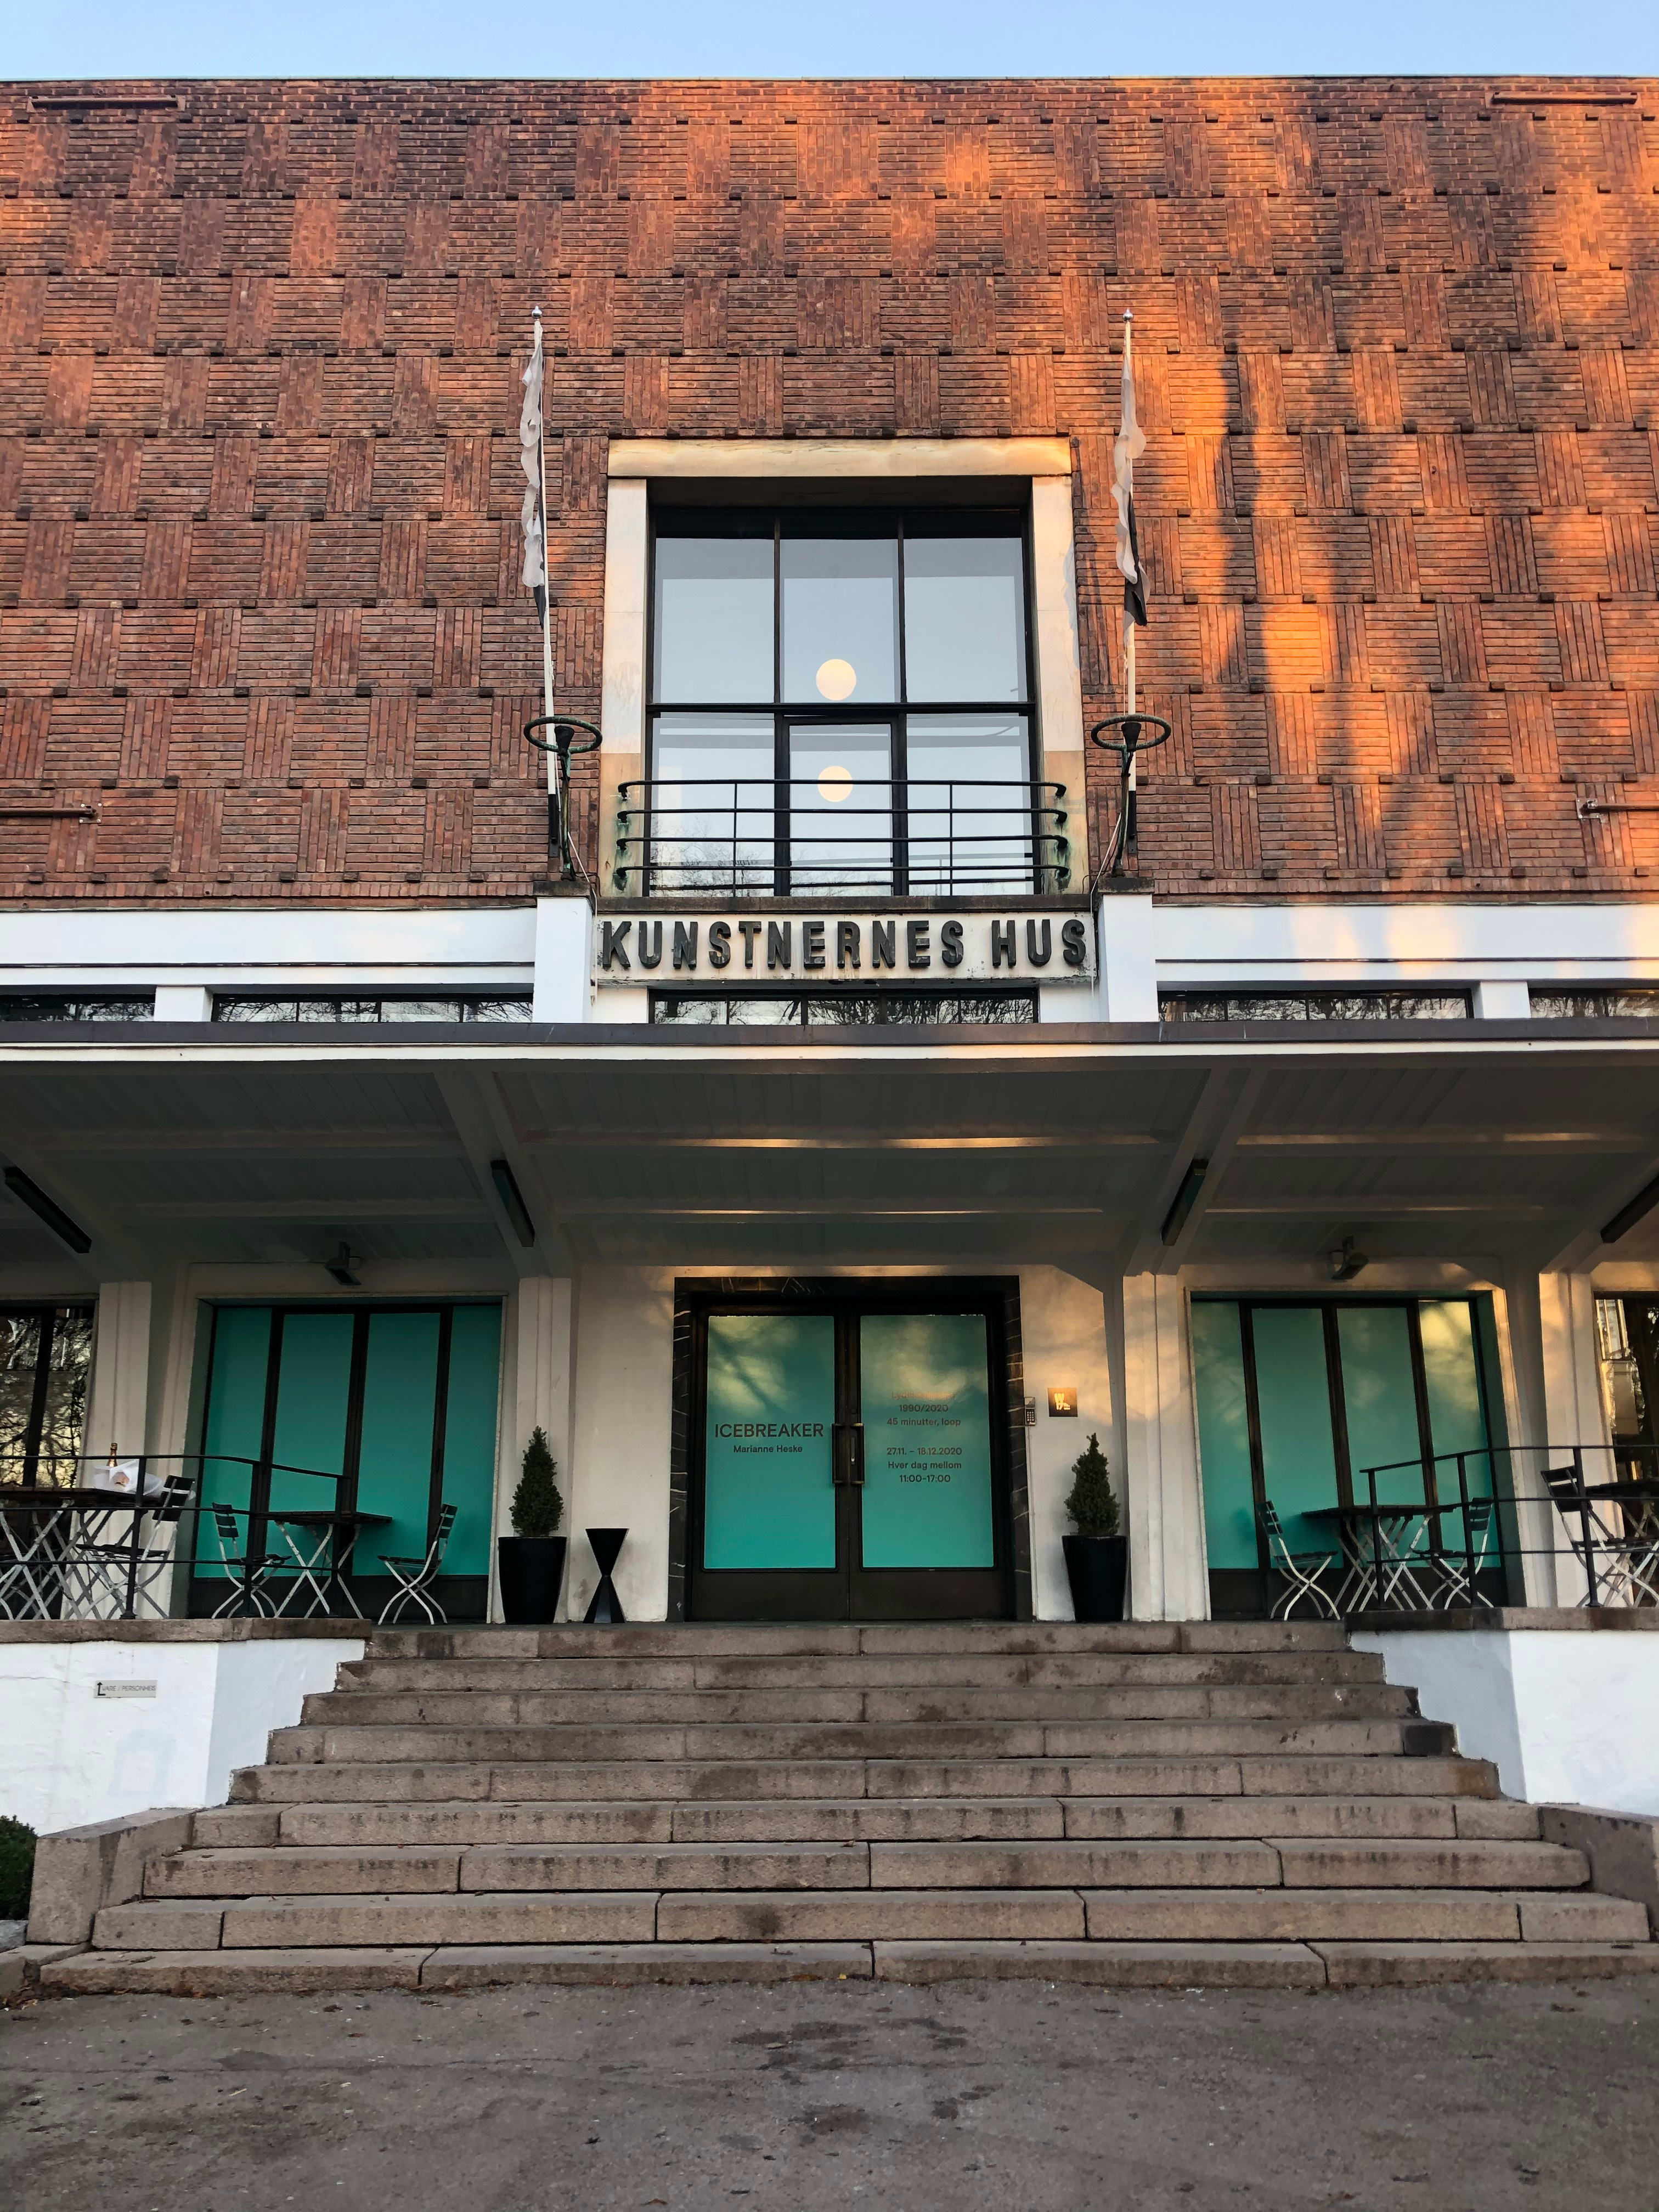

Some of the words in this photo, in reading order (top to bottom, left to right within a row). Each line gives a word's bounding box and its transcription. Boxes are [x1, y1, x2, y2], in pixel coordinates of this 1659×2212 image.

[602, 919, 964, 969] KUNSTNERNES
[991, 918, 1086, 967] HUS
[899, 1404, 949, 1413] 1990/2020
[901, 1417, 939, 1426] minutter,
[941, 1417, 961, 1427] loop
[715, 1423, 824, 1438] ICEBREAKER
[733, 1444, 774, 1453] Marianne
[776, 1444, 803, 1453] Heske
[917, 1447, 962, 1455] 18.12.2020
[911, 1461, 927, 1471] dag
